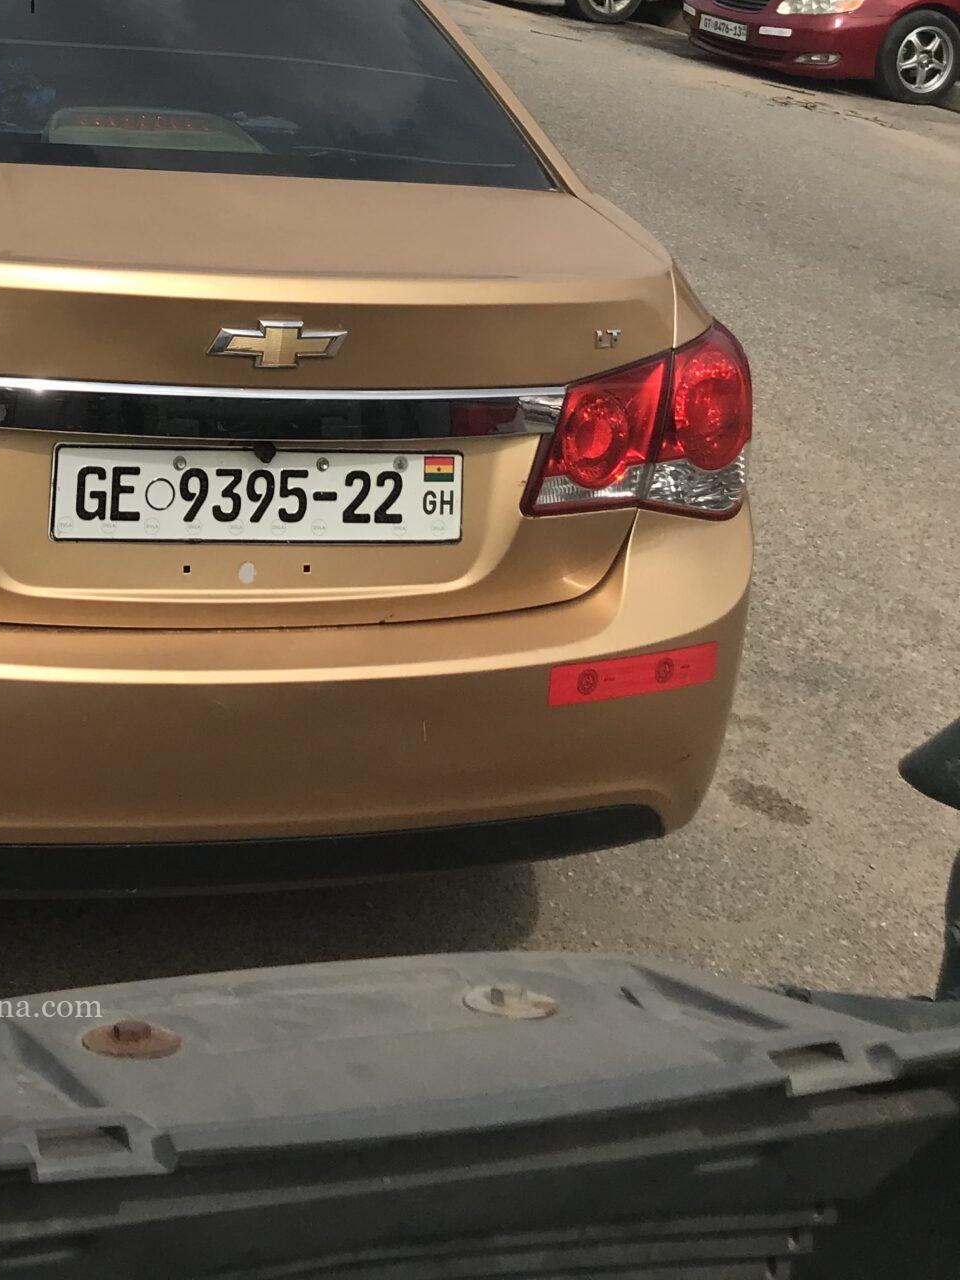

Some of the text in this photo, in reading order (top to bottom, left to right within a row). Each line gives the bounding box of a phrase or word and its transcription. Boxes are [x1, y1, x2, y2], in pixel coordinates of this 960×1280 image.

[76, 466, 403, 523] GE 9395-22
[423, 490, 454, 515] GH
